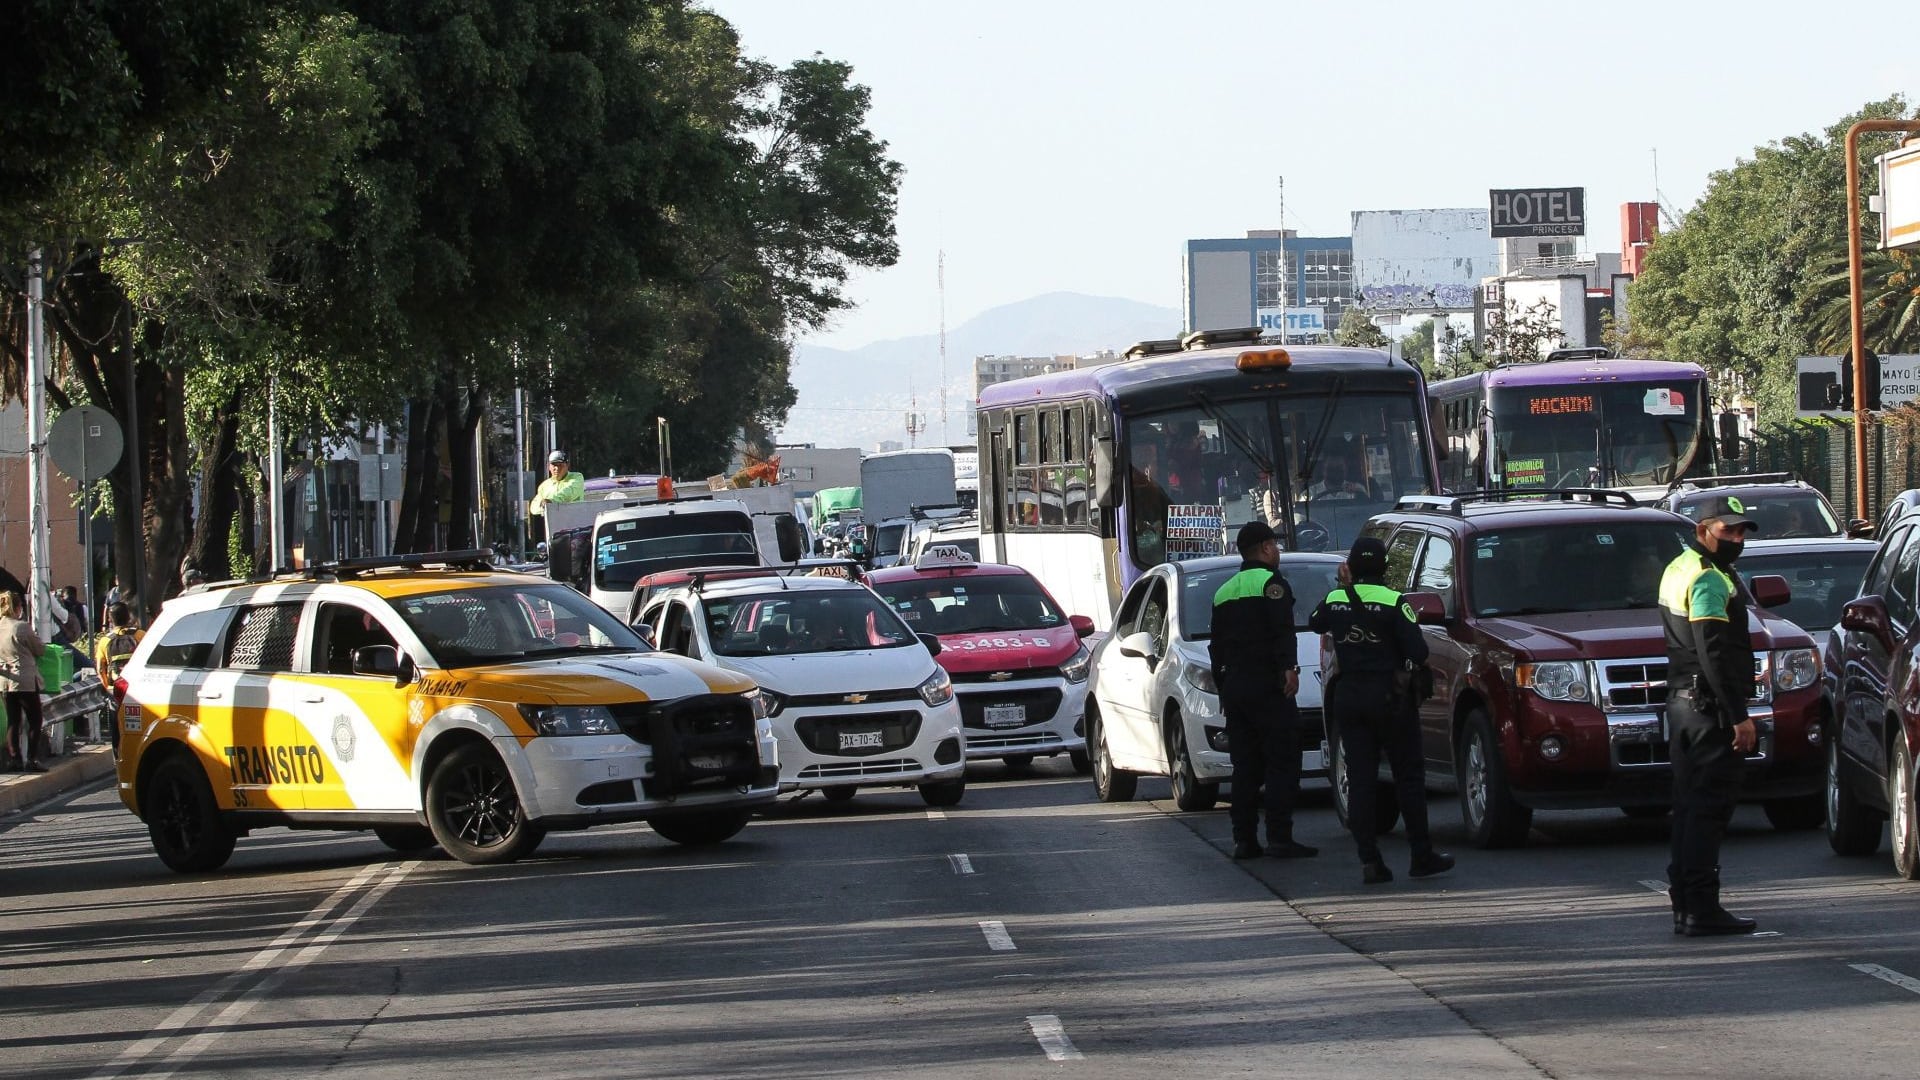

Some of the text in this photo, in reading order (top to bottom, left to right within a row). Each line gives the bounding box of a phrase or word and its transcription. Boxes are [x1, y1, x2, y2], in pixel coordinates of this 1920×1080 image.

[1493, 192, 1581, 224] HOTEL
[1532, 225, 1579, 233] PRINCESA
[1261, 314, 1323, 329] HOTEL
[1882, 370, 1910, 379] MAYO
[1169, 506, 1222, 517] TLALPAN
[1168, 518, 1222, 528] HOSPITALES
[1167, 528, 1221, 538] PERIFERICO
[1167, 541, 1220, 553] HUIPULCO
[935, 548, 958, 558] TAXI
[818, 567, 841, 576] TAXI
[234, 647, 256, 655] SSC
[126, 706, 141, 717] 911
[224, 745, 324, 784] TRANSITO
